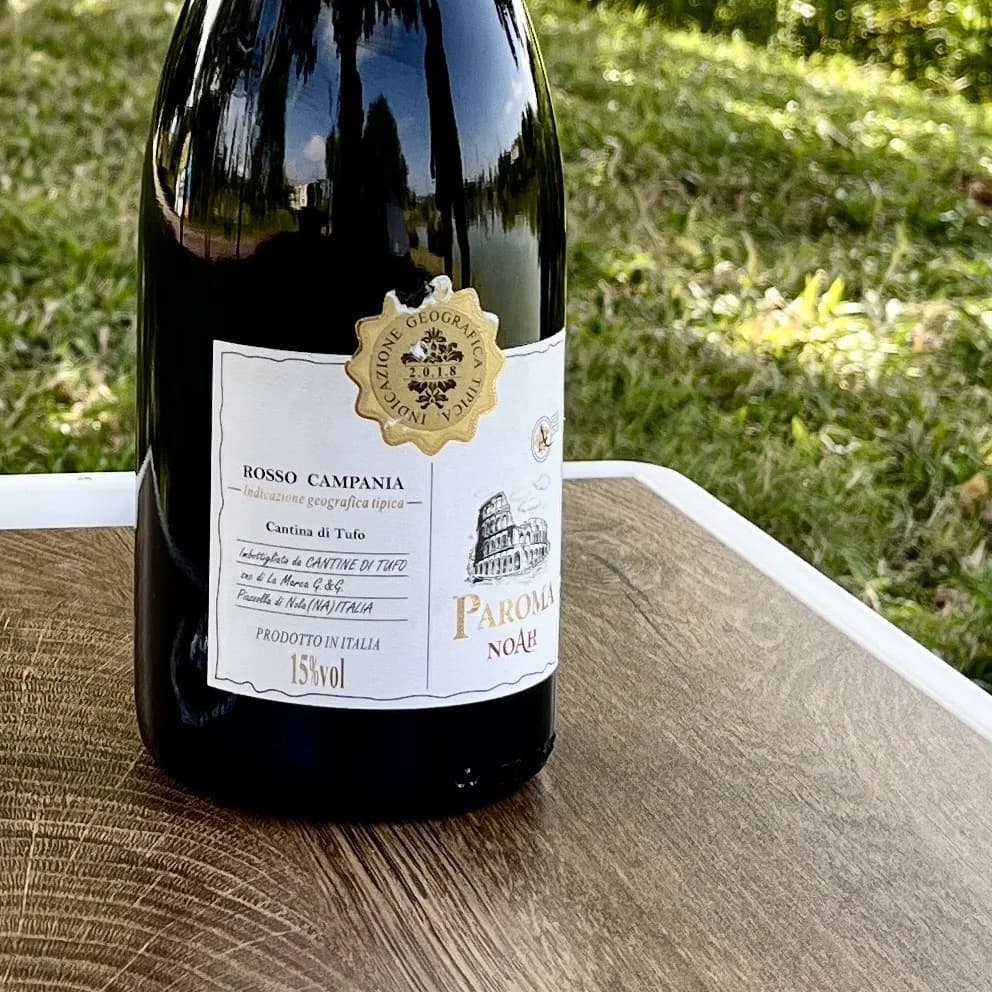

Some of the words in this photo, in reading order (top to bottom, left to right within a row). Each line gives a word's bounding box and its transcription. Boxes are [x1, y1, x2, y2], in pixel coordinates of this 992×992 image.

[406, 310, 484, 369] GEOGRAFICA
[376, 328, 426, 425] INDICAZIONE
[442, 378, 482, 423] TIPICA
[243, 464, 298, 485] ROSSO
[307, 472, 405, 491] CAMPANIA
[243, 485, 305, 505] Indicazione
[307, 494, 369, 511] geografica
[372, 497, 405, 512] tipica
[265, 520, 313, 538] Cantina
[318, 526, 330, 539] di
[333, 527, 366, 541] Tufo
[305, 555, 359, 572] CANTINE
[359, 559, 374, 573] DI
[376, 558, 408, 572] TUFO
[256, 626, 323, 648] PRODOTTO
[324, 635, 338, 649] IN
[340, 636, 381, 651] ITALIA
[487, 626, 537, 660] NOAH
